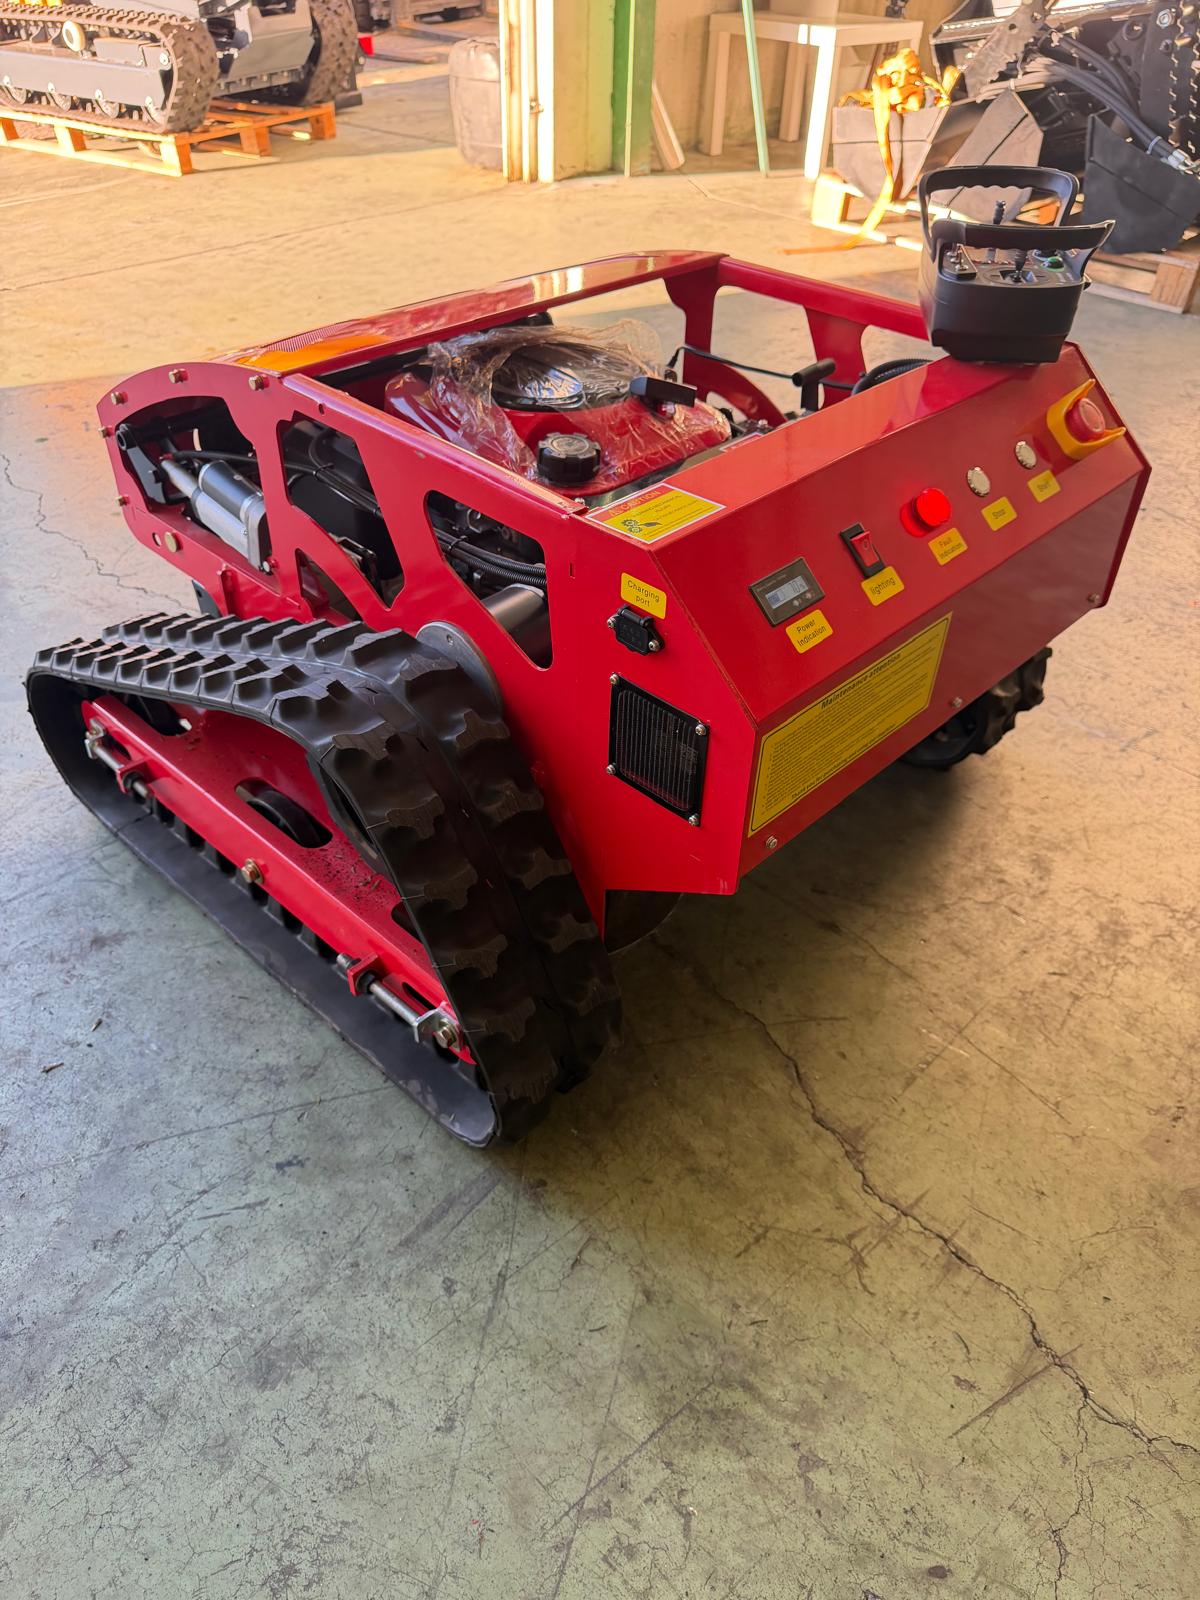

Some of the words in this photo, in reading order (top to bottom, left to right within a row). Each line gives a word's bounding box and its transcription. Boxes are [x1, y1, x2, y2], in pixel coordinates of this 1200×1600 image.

[627, 579, 660, 602] Charging
[635, 594, 651, 607] port
[796, 618, 816, 634] Power
[821, 675, 868, 709] Maintenance
